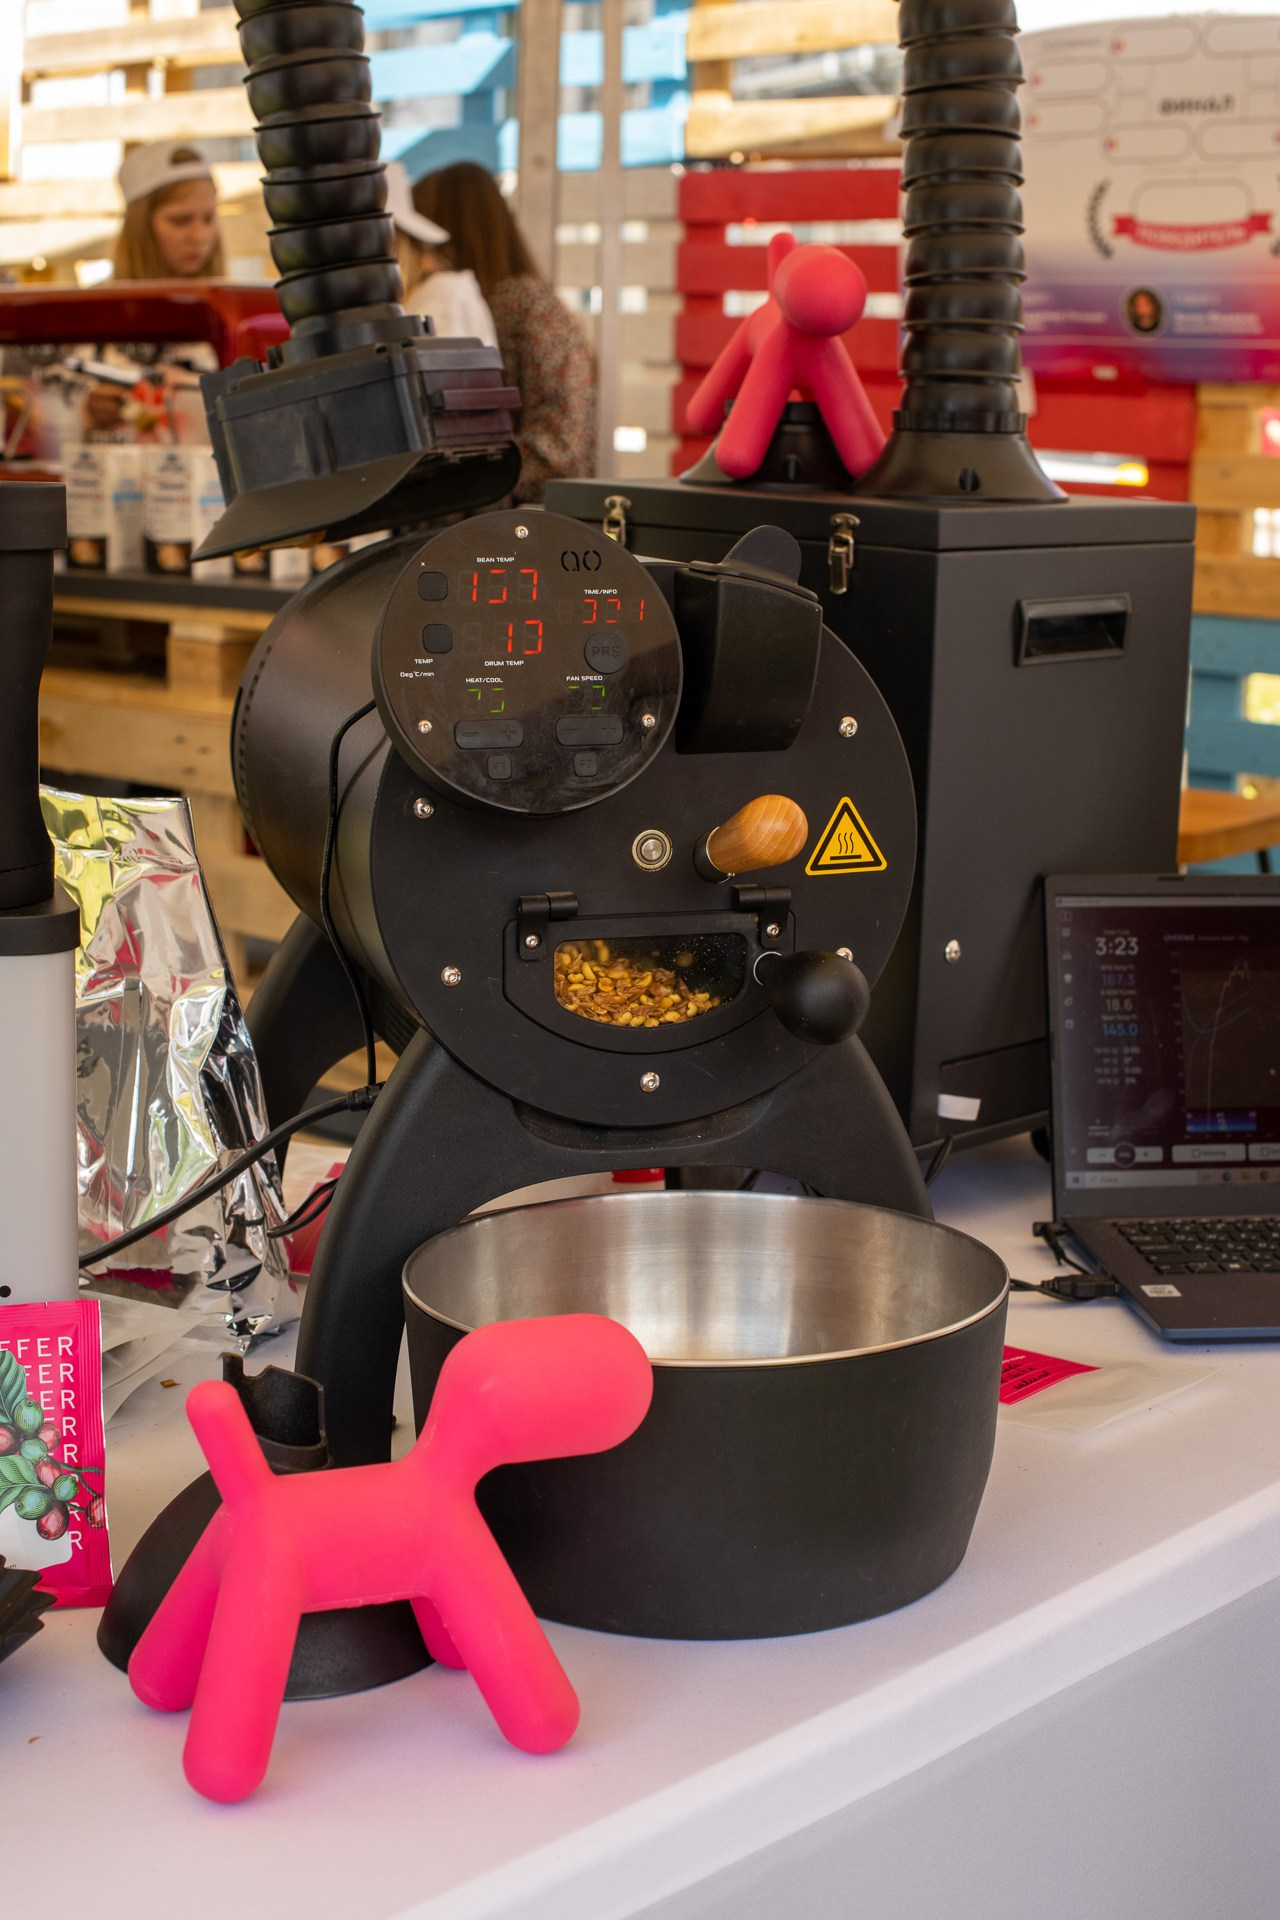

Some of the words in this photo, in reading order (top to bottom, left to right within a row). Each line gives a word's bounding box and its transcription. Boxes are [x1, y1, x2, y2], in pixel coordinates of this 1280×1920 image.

[1095, 936, 1139, 956] 3:23
[1101, 973, 1136, 987] 167.3
[1105, 998, 1133, 1012] 18.6
[1102, 1023, 1138, 1037] 145.0
